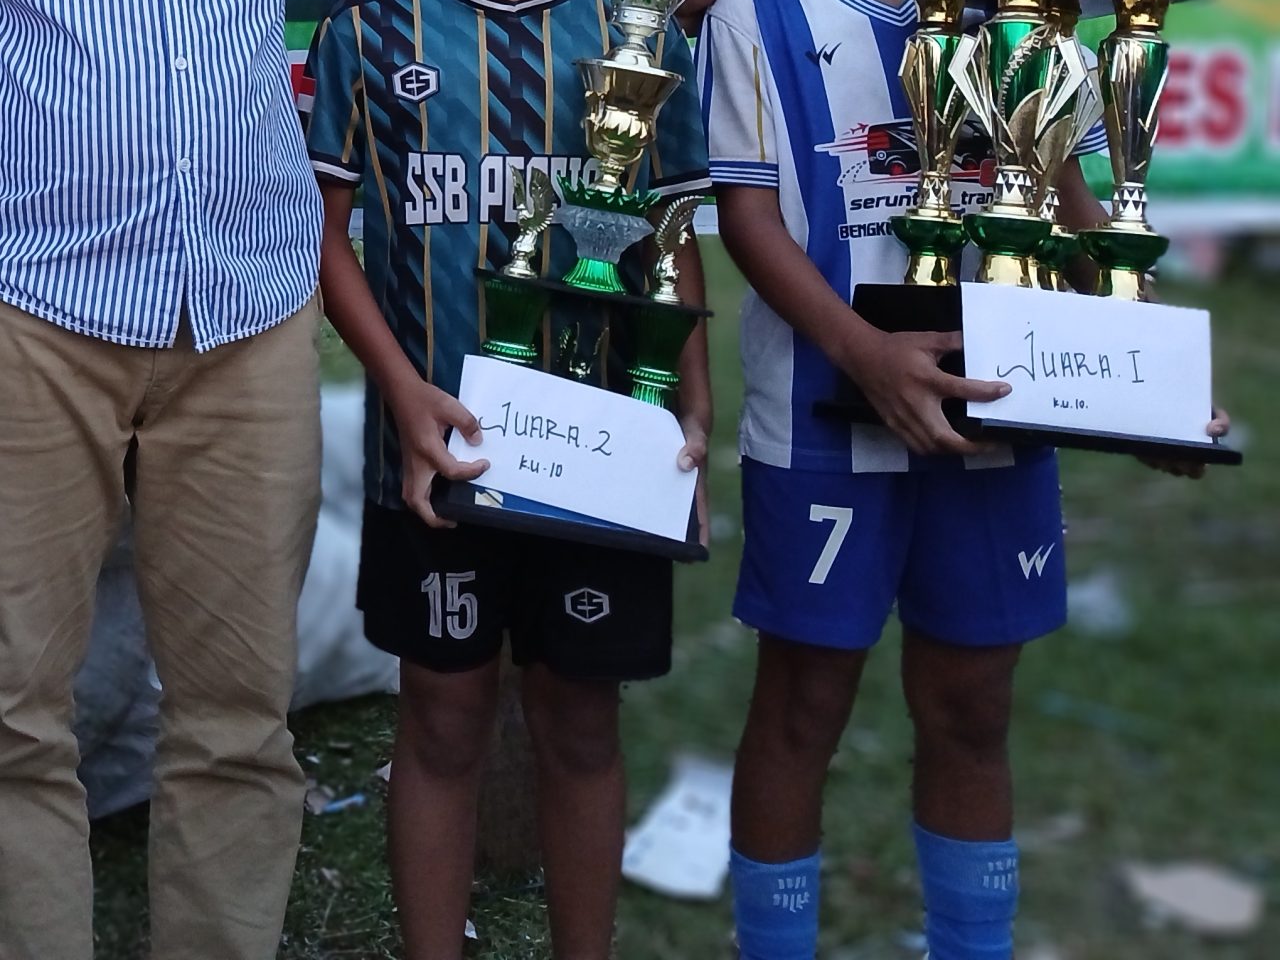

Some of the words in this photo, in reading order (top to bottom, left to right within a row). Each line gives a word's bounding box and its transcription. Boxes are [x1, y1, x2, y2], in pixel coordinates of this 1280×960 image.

[406, 152, 468, 225] SSB
[808, 503, 854, 585] 7
[420, 570, 478, 640] 15
